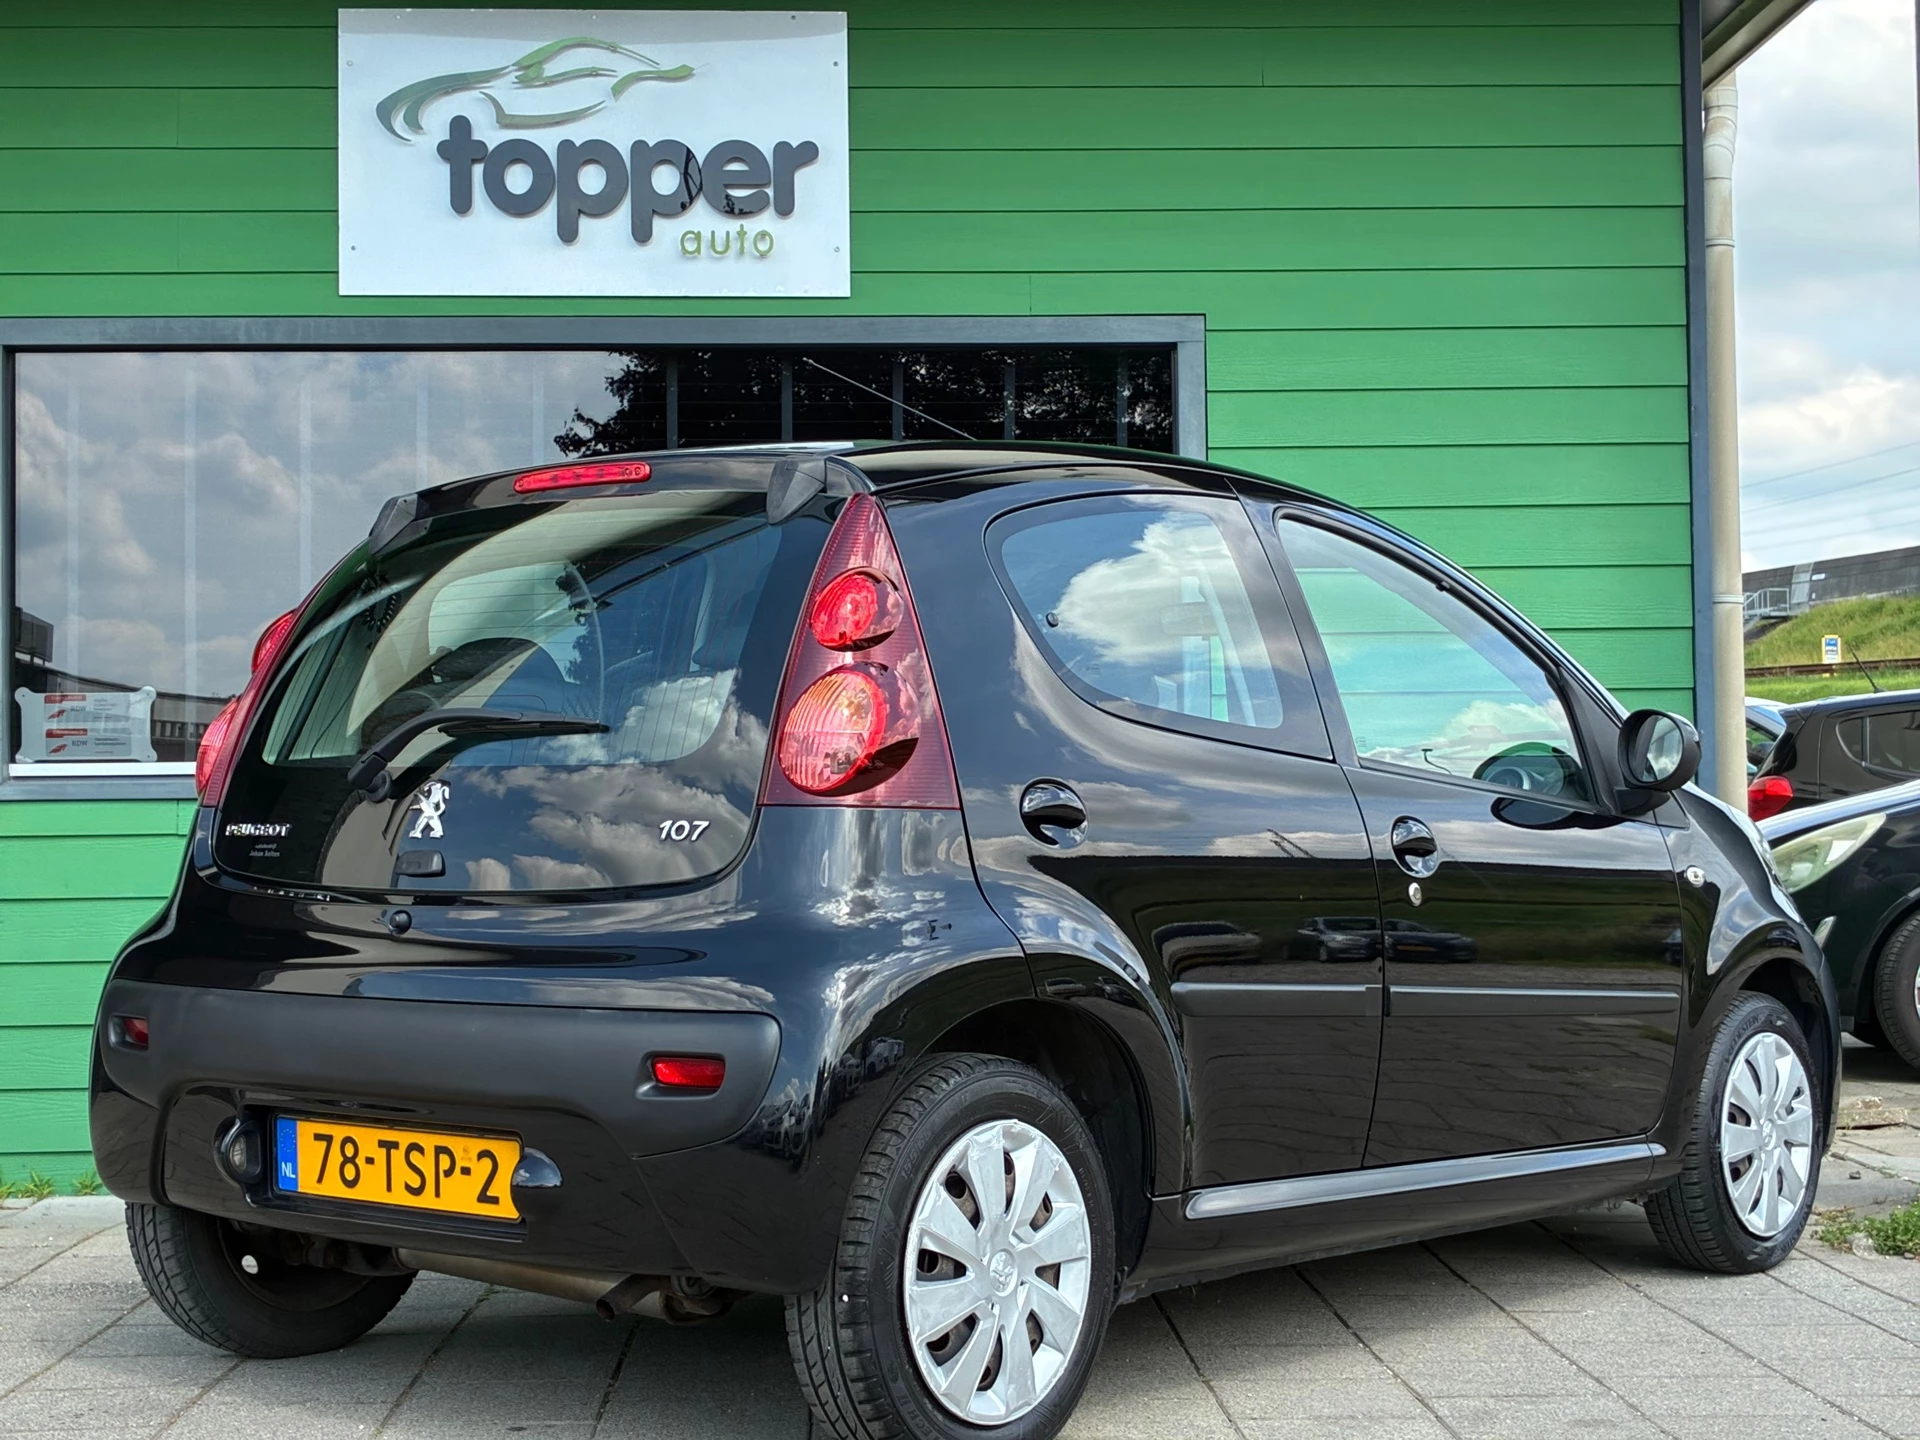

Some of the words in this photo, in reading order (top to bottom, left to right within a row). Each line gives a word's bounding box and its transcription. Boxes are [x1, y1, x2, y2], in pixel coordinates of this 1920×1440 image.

[436, 115, 819, 244] topper
[680, 223, 775, 257] auto
[225, 823, 292, 837] PEUGEOT
[659, 820, 710, 841] 107
[281, 1161, 296, 1179] NL
[313, 1132, 500, 1205] 78-TSP-2
